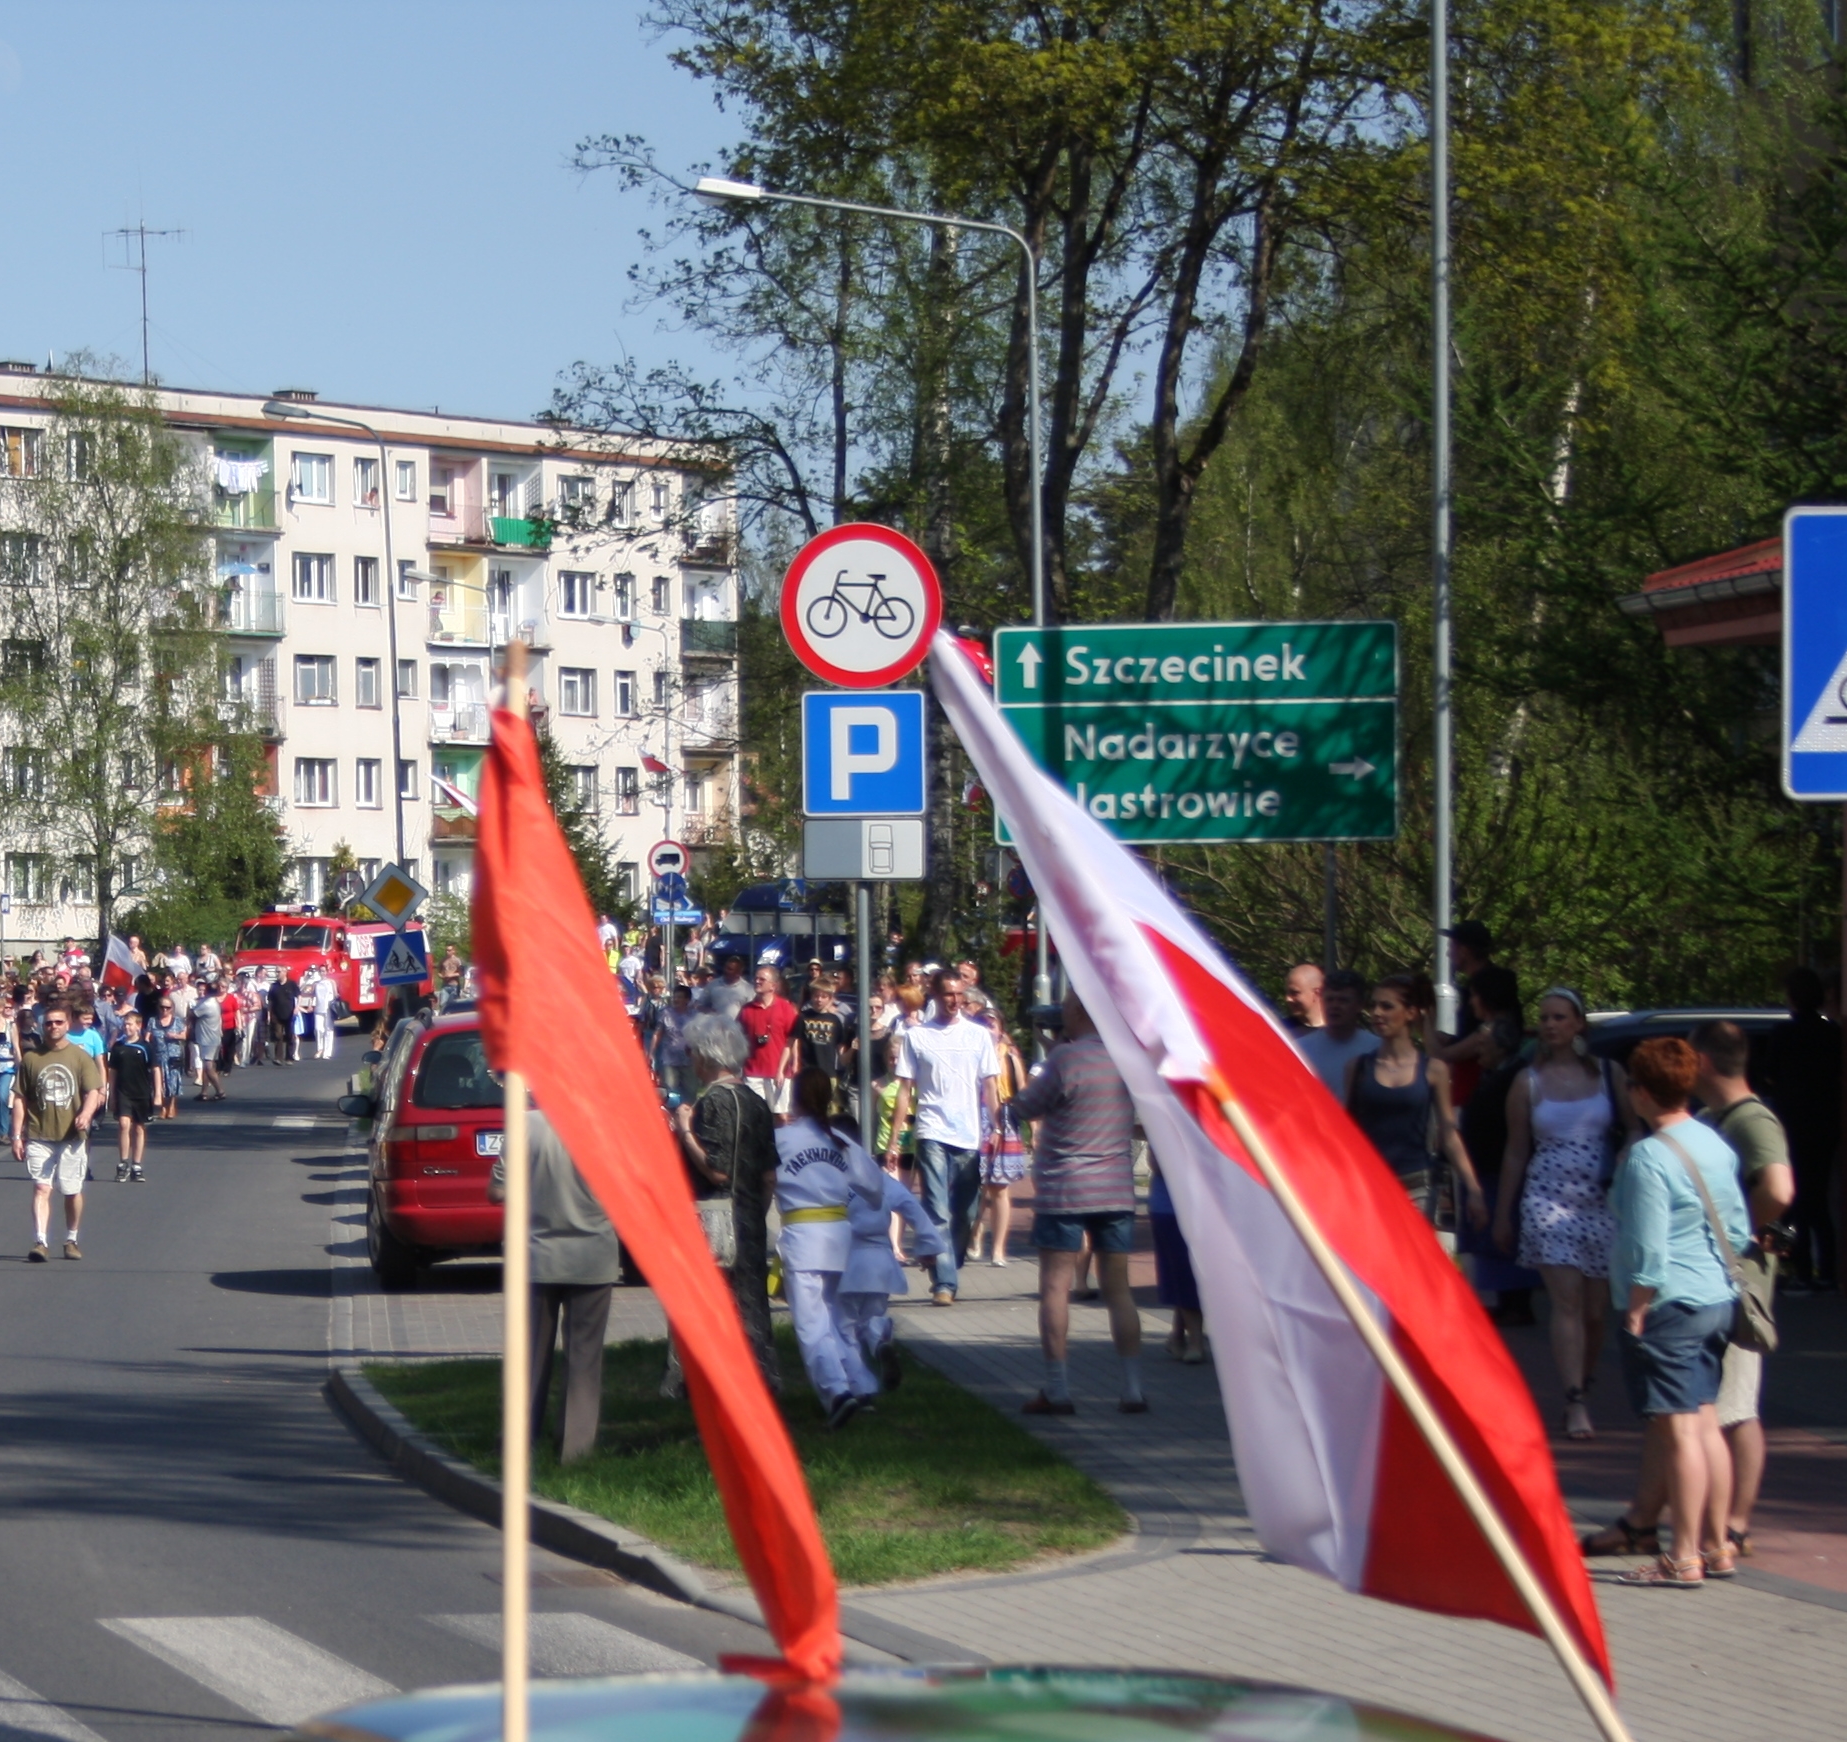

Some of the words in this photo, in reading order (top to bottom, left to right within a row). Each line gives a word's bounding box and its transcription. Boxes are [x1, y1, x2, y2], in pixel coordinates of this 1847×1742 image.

[1065, 643, 1306, 685] Szczecinek
[830, 706, 896, 800] P
[1064, 722, 1299, 769] Nadarzyce
